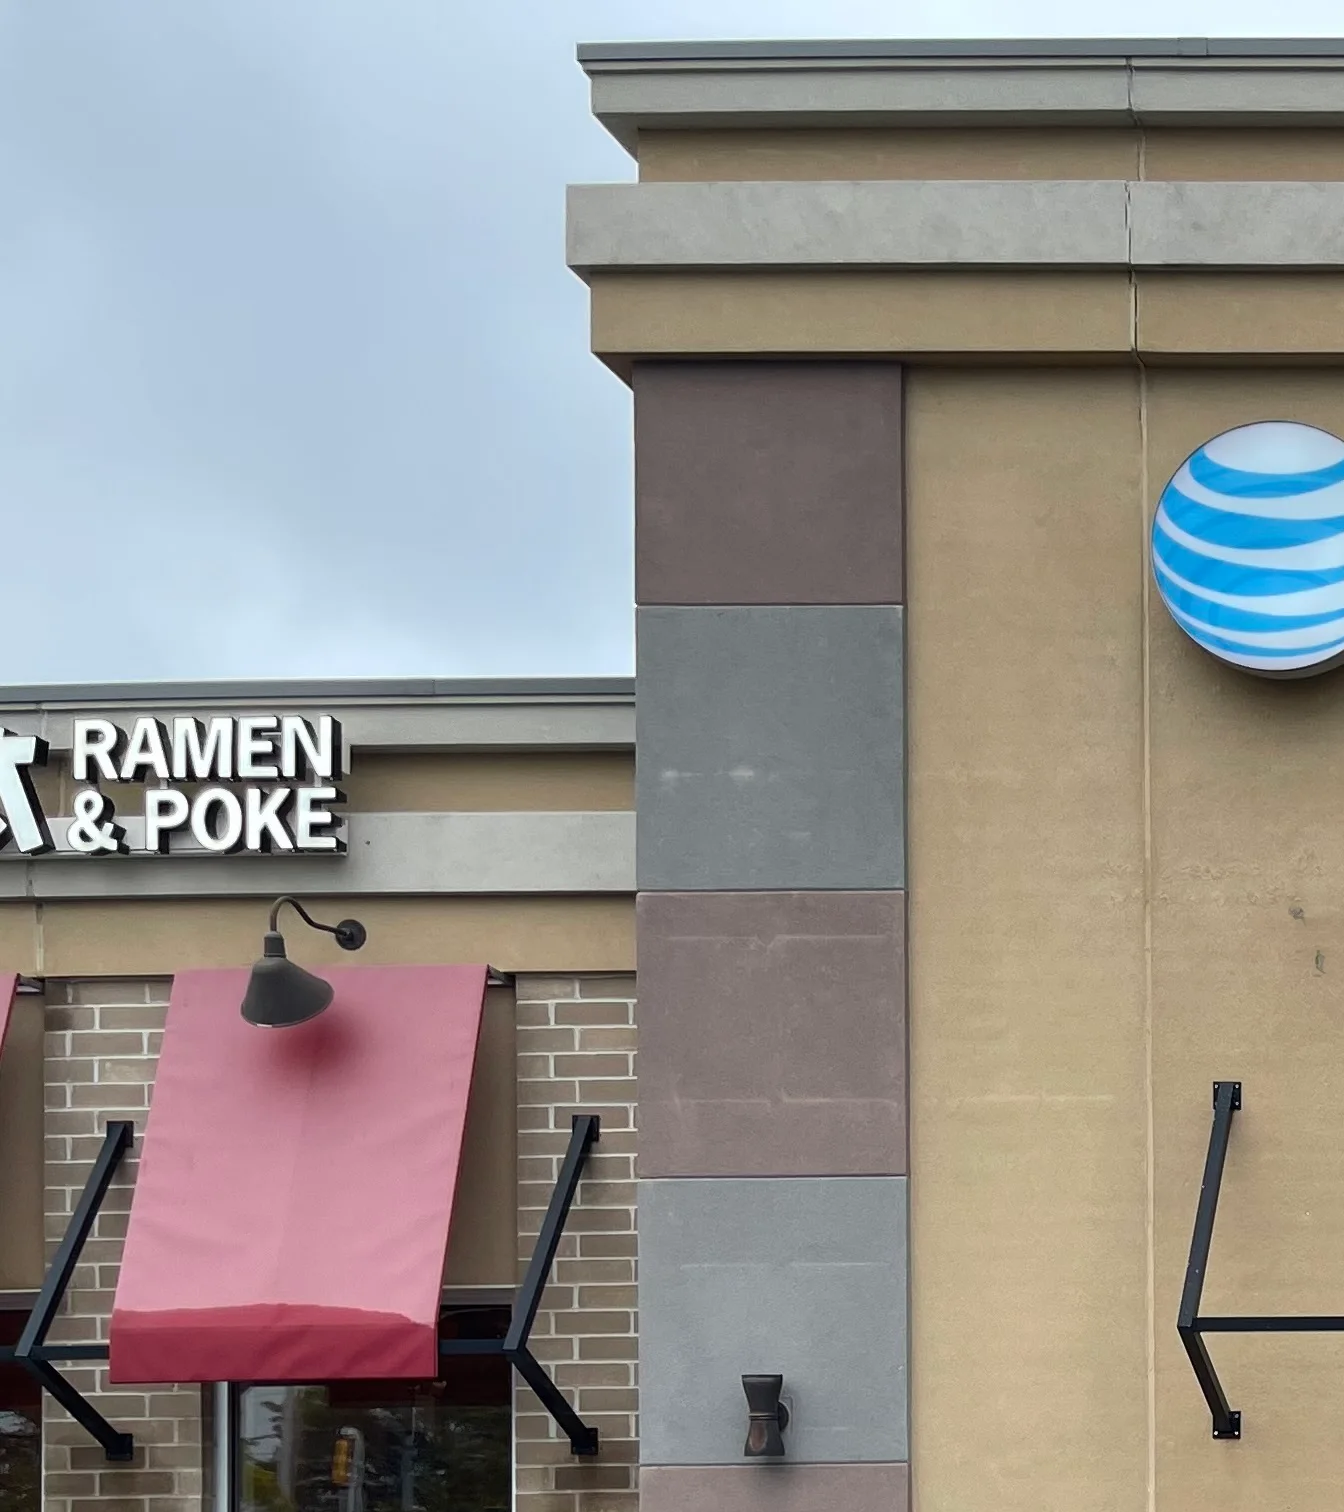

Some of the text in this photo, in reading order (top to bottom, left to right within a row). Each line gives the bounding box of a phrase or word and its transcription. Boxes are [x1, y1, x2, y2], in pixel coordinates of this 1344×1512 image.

[72, 715, 337, 780] RAMEN
[66, 788, 120, 853] &
[144, 787, 340, 853] POKE
